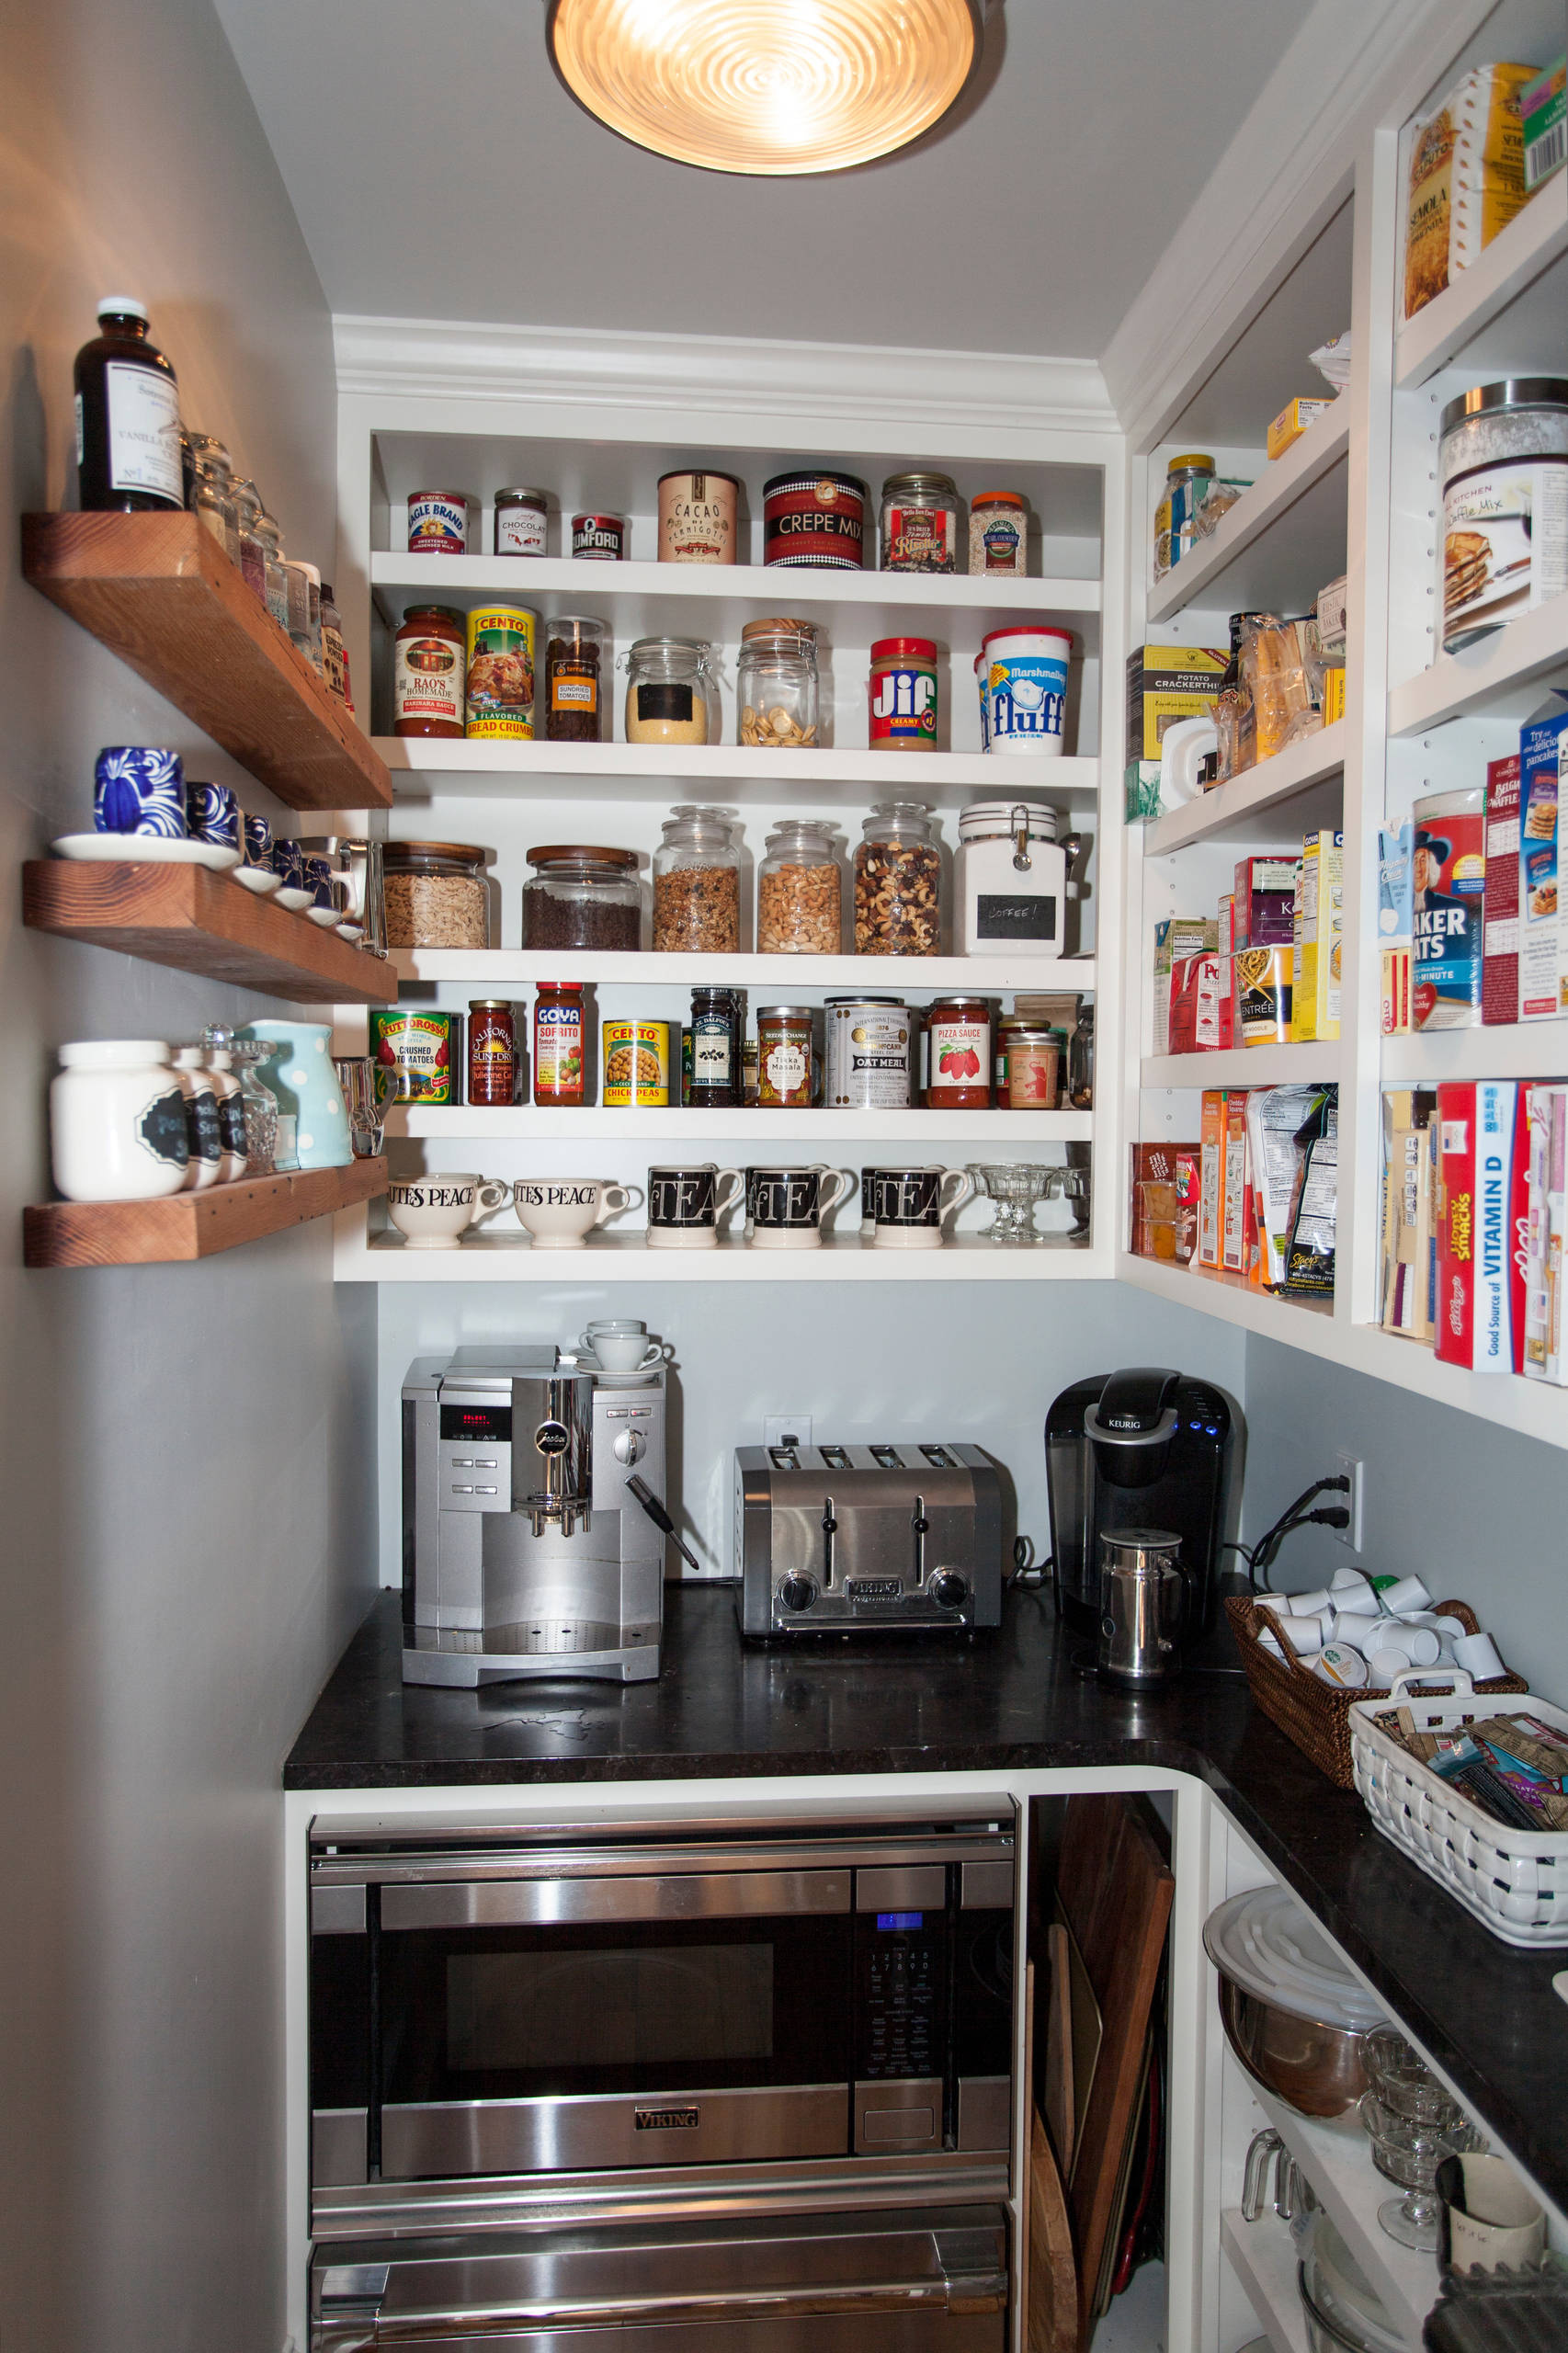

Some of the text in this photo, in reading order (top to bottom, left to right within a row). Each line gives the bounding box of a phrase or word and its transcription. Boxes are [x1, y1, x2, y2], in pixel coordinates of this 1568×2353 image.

[1453, 485, 1493, 504] KITCHEN
[676, 504, 720, 517] CACAO
[1480, 500, 1504, 512] Mix
[433, 504, 463, 530] BRAND
[779, 514, 863, 540] CREPE MIX
[480, 618, 524, 631] CENTO
[415, 677, 446, 690] RAO'S
[1155, 680, 1219, 689] CRACKERTHI
[407, 688, 452, 699] HOMEMADE
[874, 675, 935, 719] Jif
[480, 713, 523, 722] FLAVORED
[994, 692, 1064, 736] fluff
[468, 722, 497, 733] BREAD
[1529, 732, 1543, 743] Try
[1526, 750, 1559, 769] pancakes
[1488, 794, 1519, 809] WAFFLE
[1242, 1000, 1275, 1017] ENTRÉE
[539, 1009, 579, 1023] GOYA
[382, 1019, 446, 1036] TUTTOROSSO
[540, 1027, 578, 1038] SOFRITO
[612, 1028, 655, 1040] CENTO
[938, 1029, 981, 1038] PIZZA SAUCE
[472, 1027, 513, 1051] CALIFORNIA
[400, 1046, 431, 1055] CRUSHED
[608, 1088, 660, 1097] CHICK PEAS
[430, 1186, 473, 1207] PEACE
[547, 1186, 596, 1206] PEACE
[1450, 1199, 1460, 1255] HONEY
[1458, 1192, 1471, 1264] SMACKS
[1483, 1155, 1503, 1357] Good Source of VITAMIN D
[1108, 1418, 1141, 1430] KEURIG
[637, 2113, 697, 2127] VIKING
